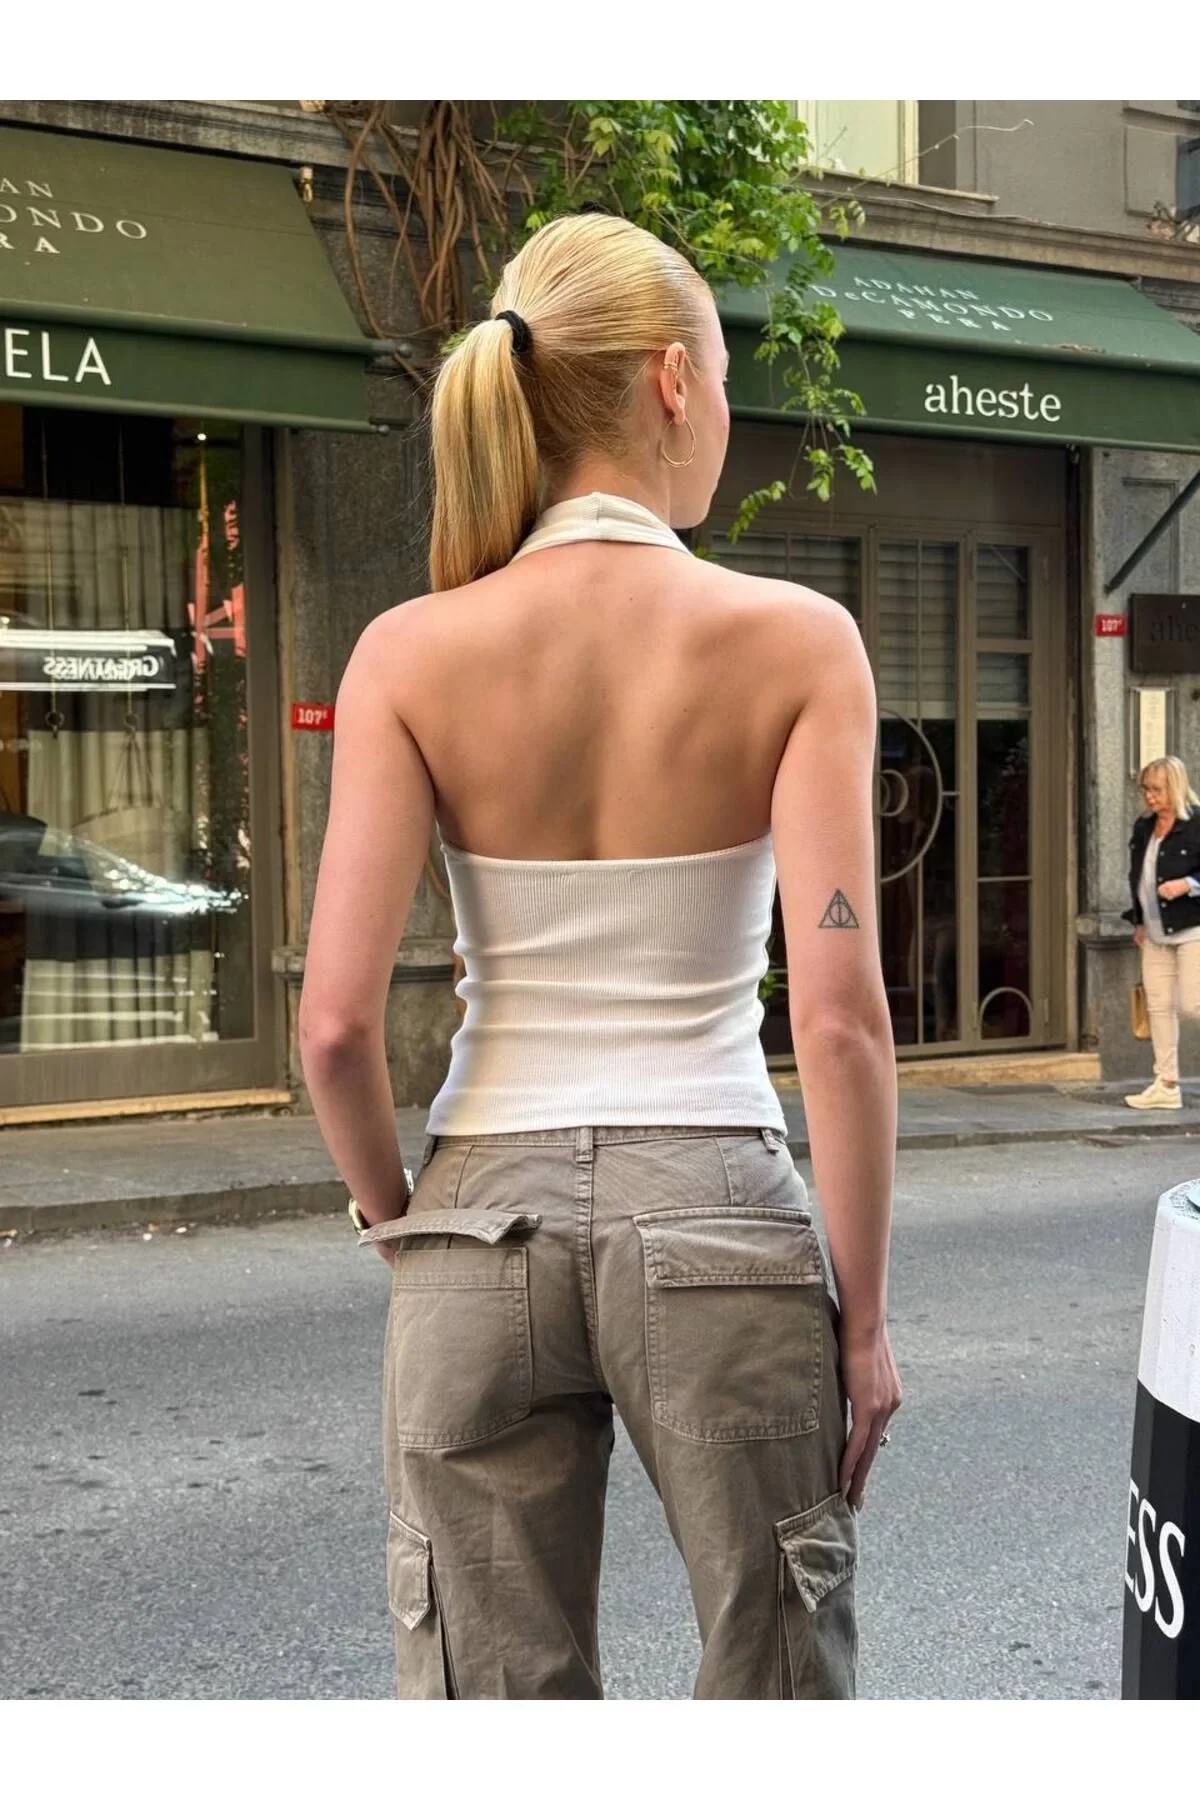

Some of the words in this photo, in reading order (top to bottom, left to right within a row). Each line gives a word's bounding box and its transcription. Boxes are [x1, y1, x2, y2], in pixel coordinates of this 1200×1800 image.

[853, 276, 979, 300] ADAHAN
[5, 327, 112, 385] ELA
[924, 374, 1062, 422] aheste
